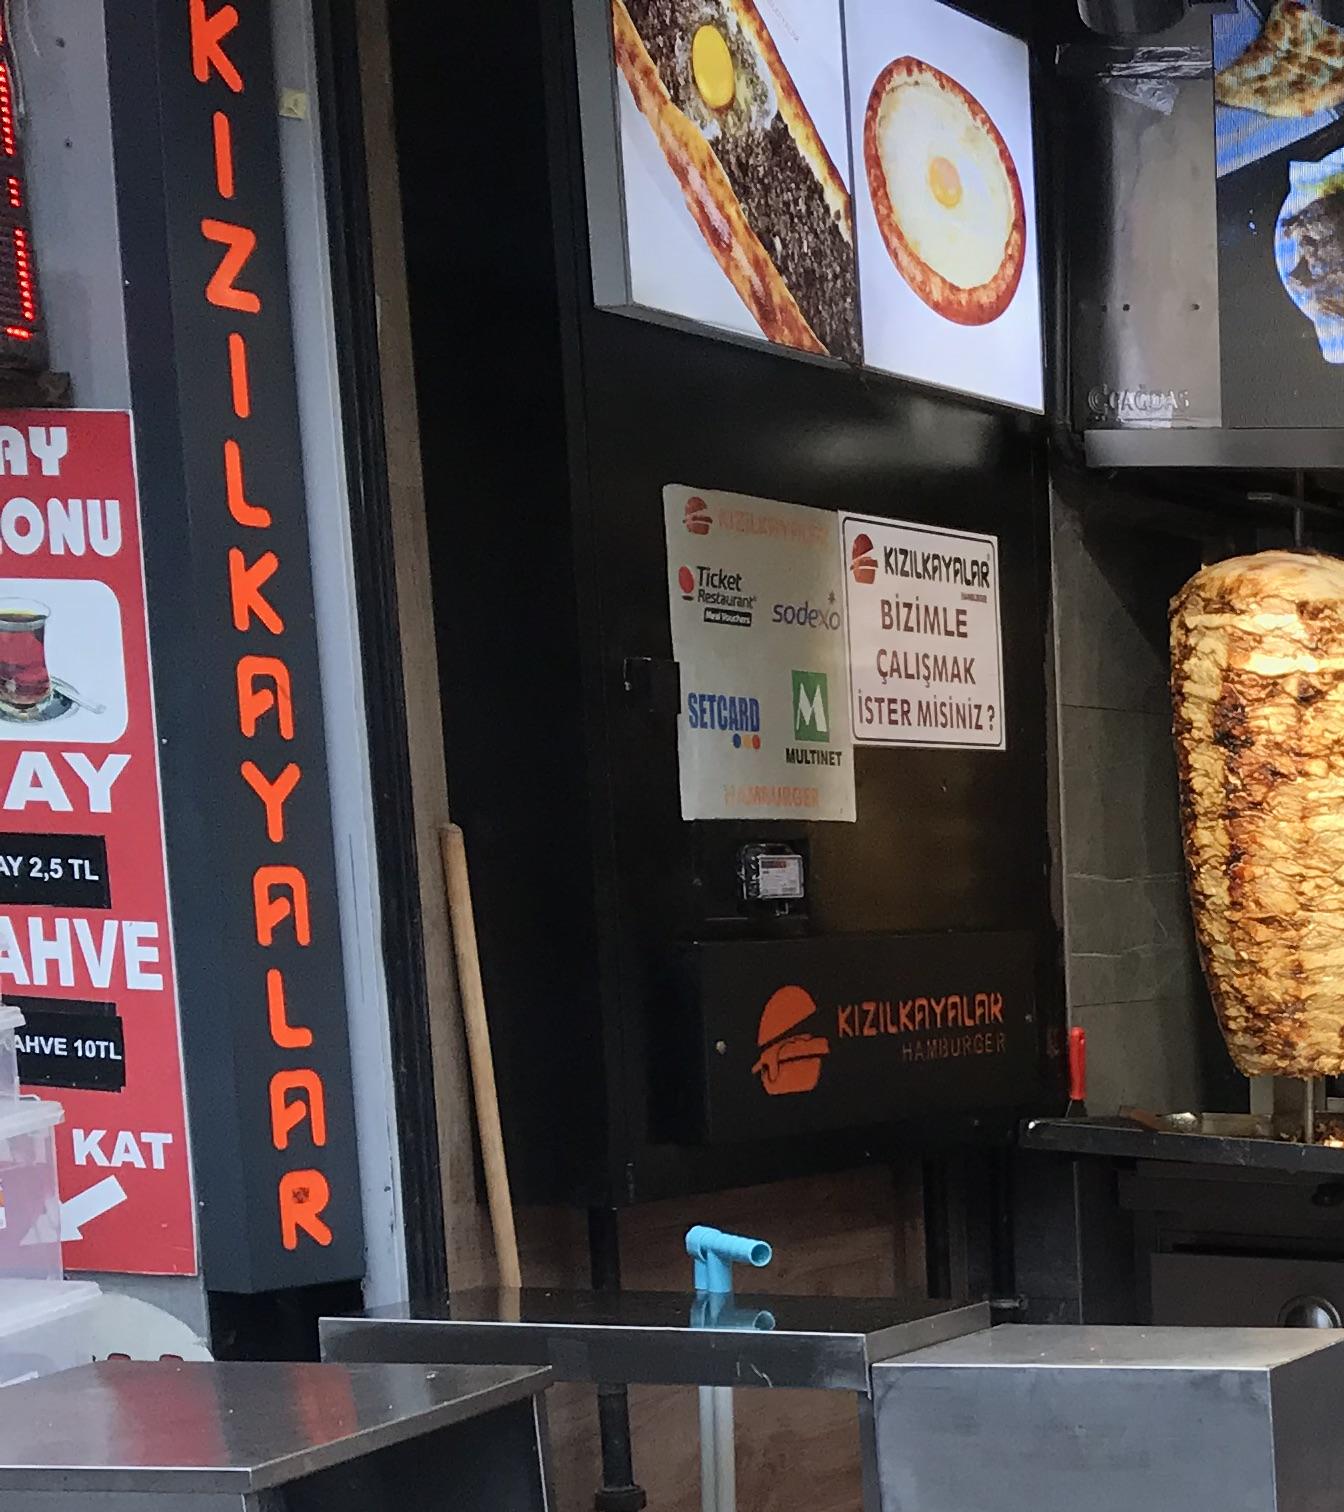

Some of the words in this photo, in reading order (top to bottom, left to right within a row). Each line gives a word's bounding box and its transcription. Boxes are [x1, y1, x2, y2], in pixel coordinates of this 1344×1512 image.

[0, 496, 122, 557] ONU
[697, 566, 743, 591] Ticket
[883, 546, 990, 588] KIZILKAYALAR
[189, 0, 332, 1250] KIZILKAYALAR
[772, 601, 840, 630] sodexo
[880, 593, 968, 638] BİZİMLE
[876, 648, 976, 688] ÇALIŞMAK
[688, 692, 761, 732] SETCARD
[858, 688, 912, 727] İSTER
[785, 748, 842, 766] MULTINET
[29, 857, 63, 881] 2,5
[68, 859, 100, 881] TL
[838, 991, 1004, 1038] KIZILKAYALAR
[74, 1038, 122, 1060] 10TL
[901, 1032, 1007, 1062] HAMBURGER
[72, 1128, 173, 1170] KAT
